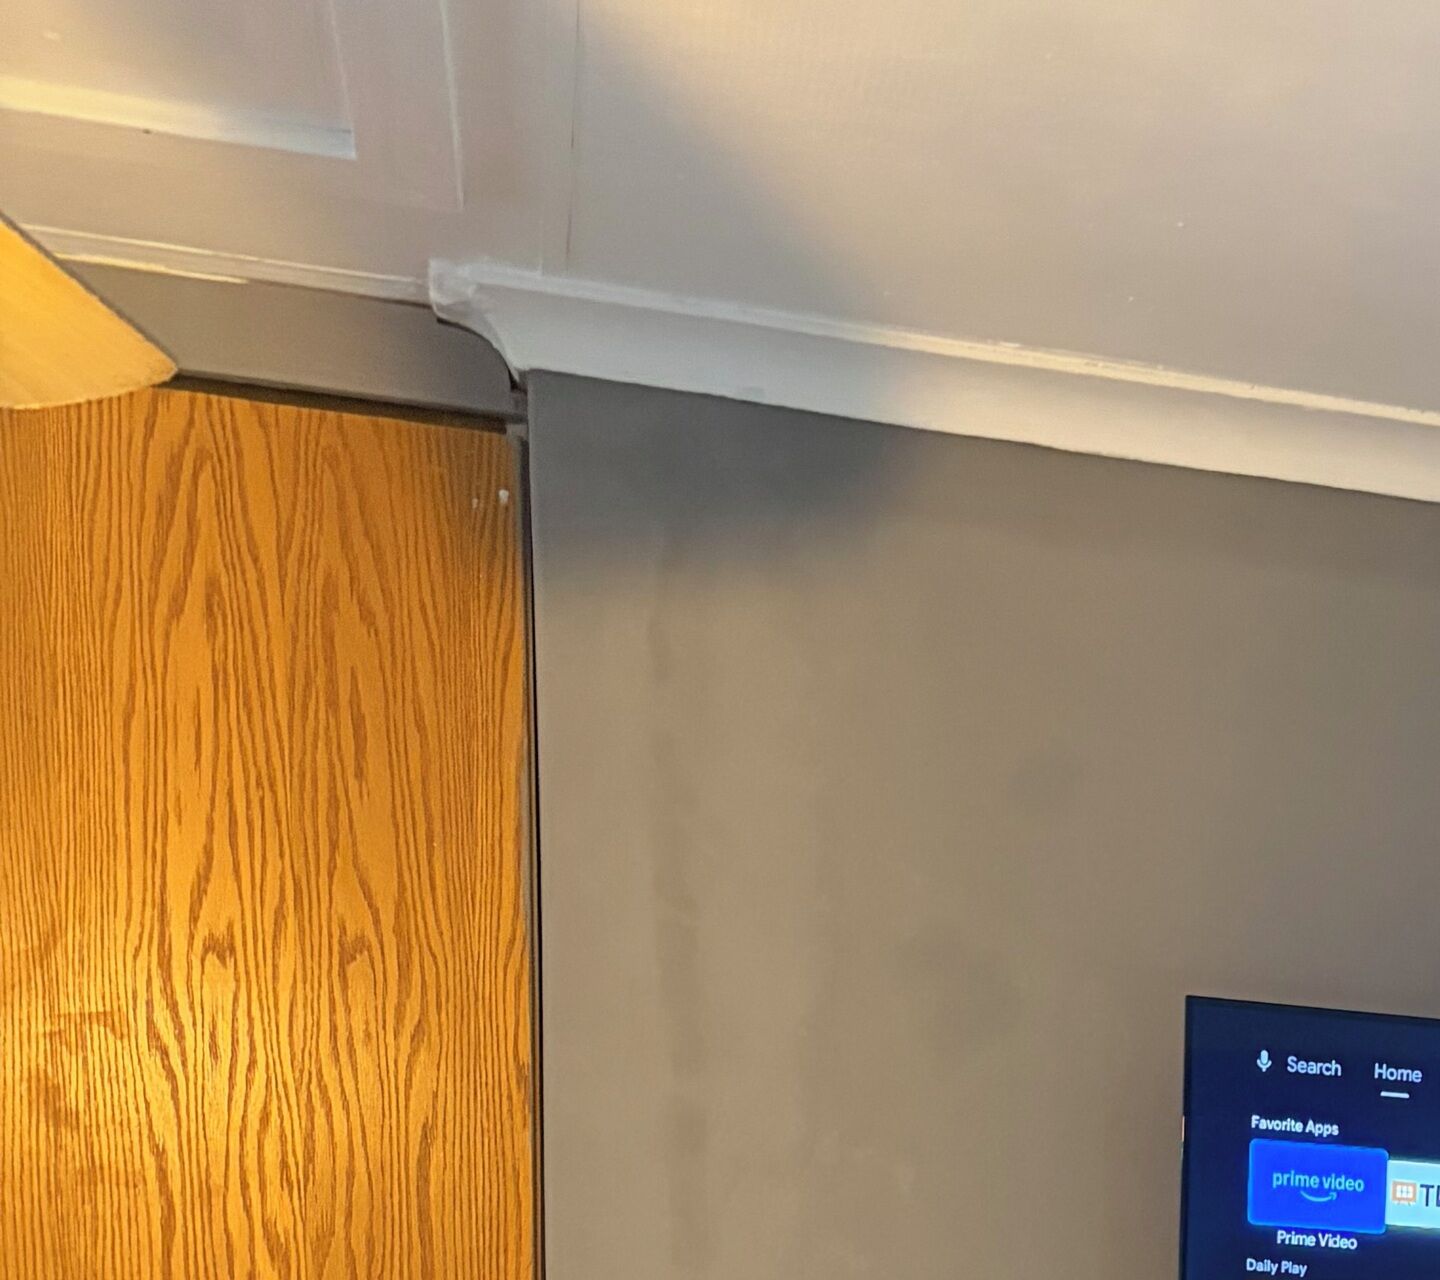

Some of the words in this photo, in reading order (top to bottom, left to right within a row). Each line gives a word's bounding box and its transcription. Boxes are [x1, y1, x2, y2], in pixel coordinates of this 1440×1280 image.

[1286, 1056, 1342, 1078] Search
[1374, 1063, 1423, 1084] Home
[1251, 1115, 1303, 1134] Favorite
[1305, 1119, 1340, 1137] Apps
[1272, 1170, 1320, 1191] prime
[1322, 1173, 1365, 1193] video
[1277, 1230, 1316, 1249] Prime
[1318, 1233, 1358, 1250] Video
[1246, 1258, 1279, 1277] Daily
[1281, 1261, 1308, 1279] Play
